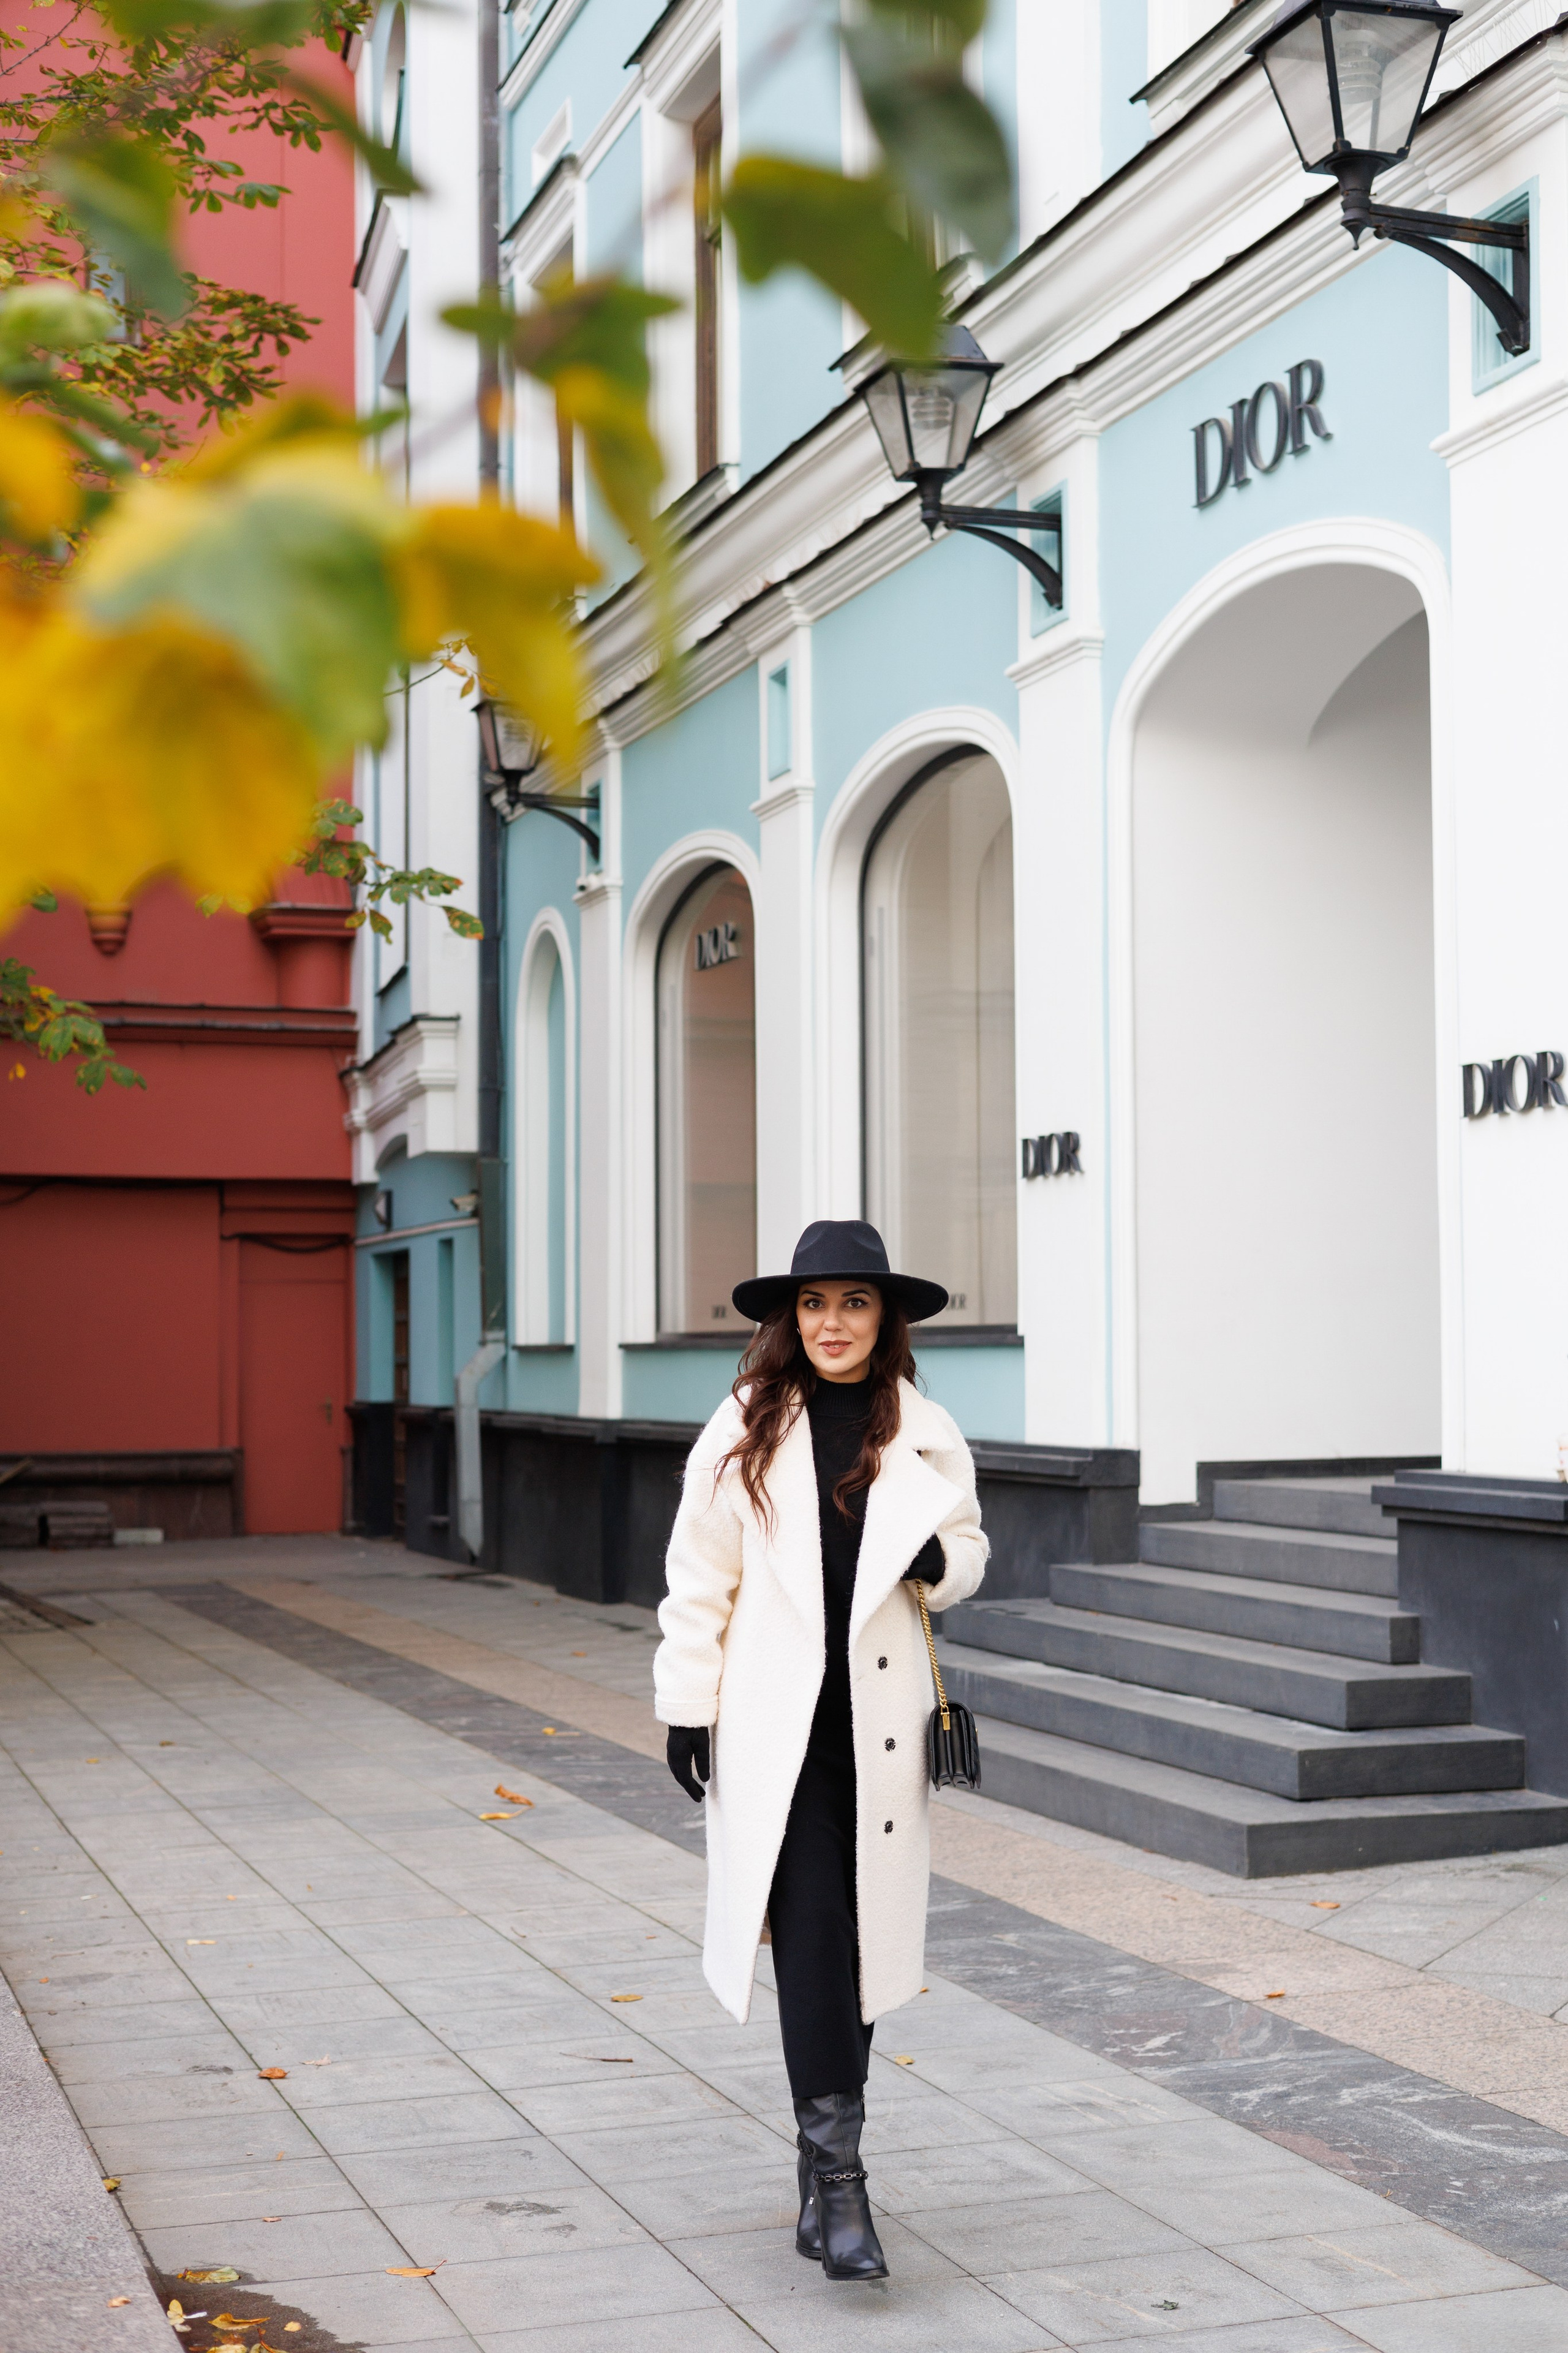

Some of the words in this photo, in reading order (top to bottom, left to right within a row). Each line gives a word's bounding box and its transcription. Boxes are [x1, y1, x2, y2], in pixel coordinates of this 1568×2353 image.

[1190, 359, 1333, 511] DIOR
[1461, 1051, 1568, 1121] DIOR
[1022, 1131, 1084, 1180] DIOR
